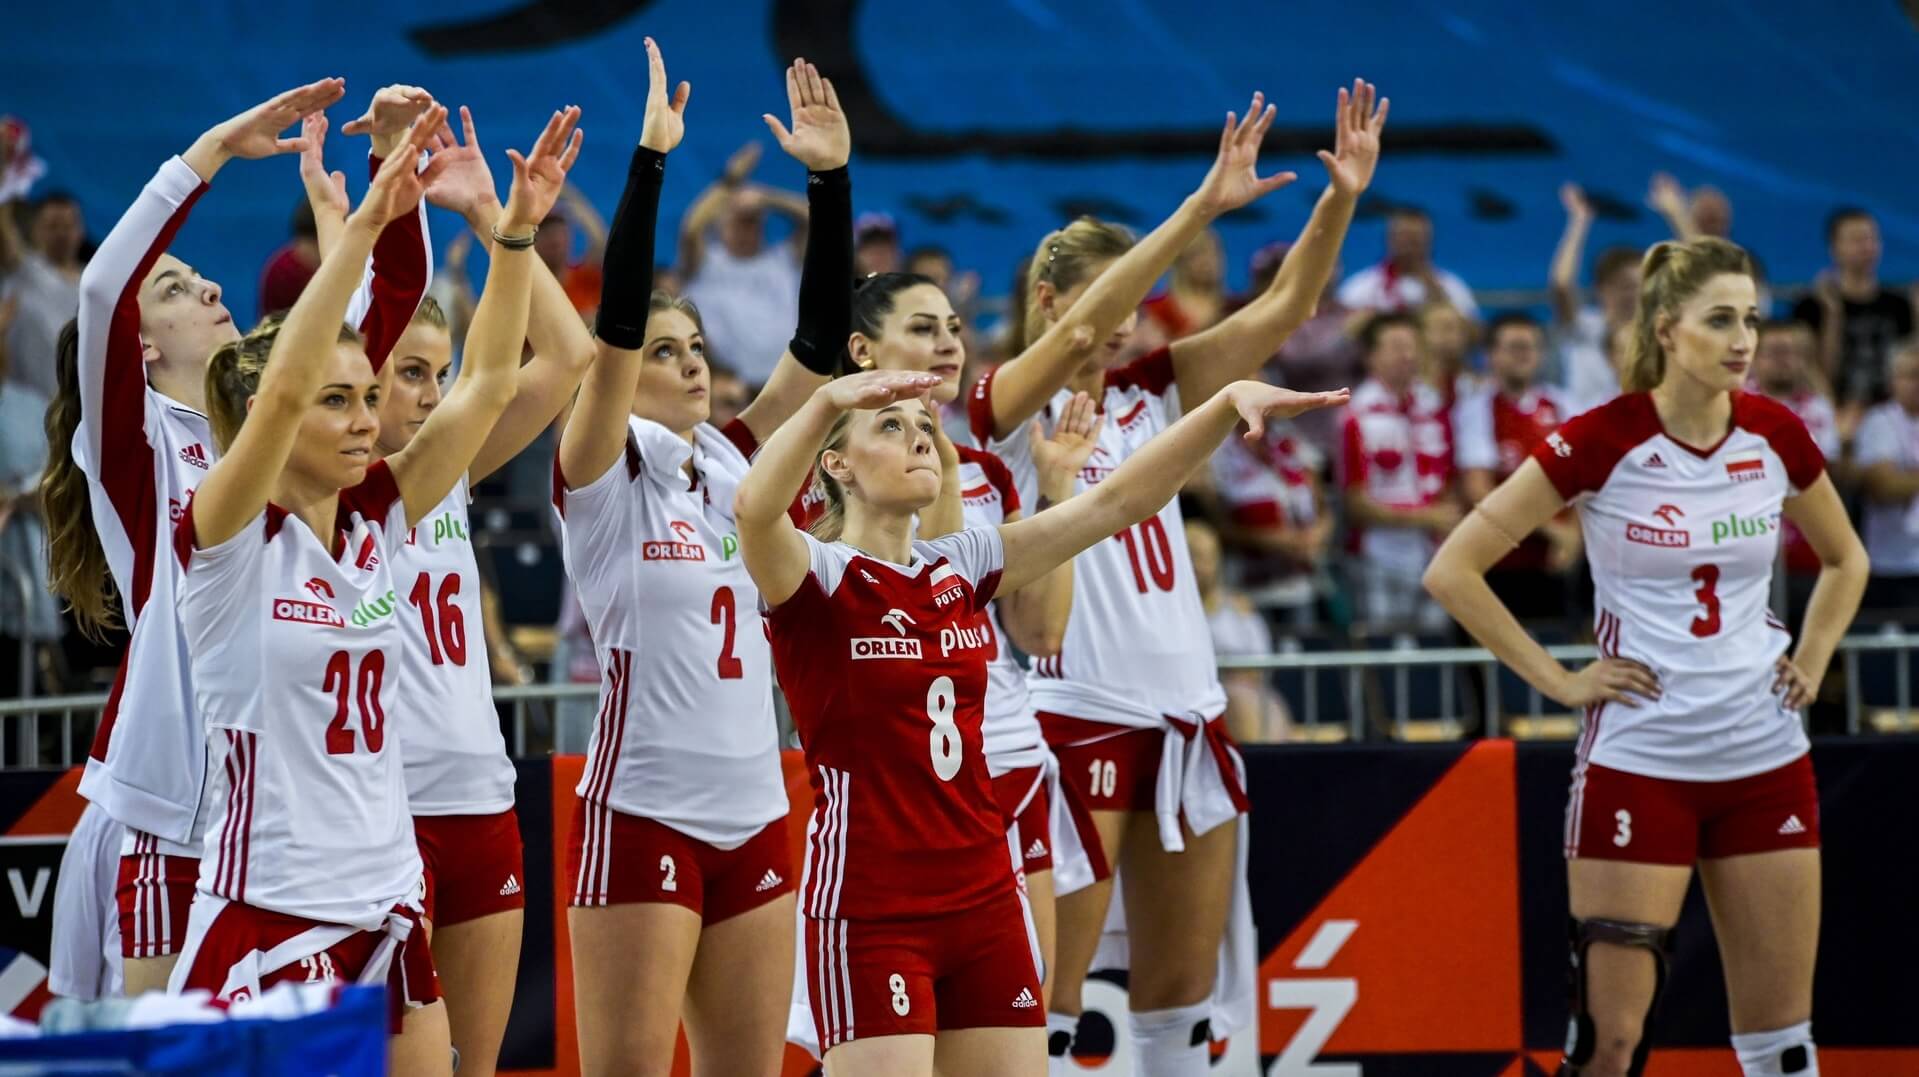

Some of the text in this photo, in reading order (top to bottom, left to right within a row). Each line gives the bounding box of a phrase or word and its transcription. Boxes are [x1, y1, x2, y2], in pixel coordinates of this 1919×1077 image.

[1629, 526, 1687, 545] ORLEN
[1712, 513, 1768, 545] plus
[646, 543, 702, 560] ORLEN
[1112, 513, 1175, 594] 10
[276, 603, 342, 625] ORLEN
[409, 571, 466, 667] 16
[1690, 564, 1722, 638] 3
[710, 586, 743, 680] 2
[855, 641, 918, 656] ORLEN
[940, 621, 982, 657] plus
[322, 649, 386, 755] 20
[926, 676, 963, 782] 8
[1088, 758, 1117, 798] 10
[1613, 808, 1632, 848] 3
[660, 854, 677, 892] 2
[889, 973, 910, 1016] 8
[1012, 999, 1037, 1008] adidas
